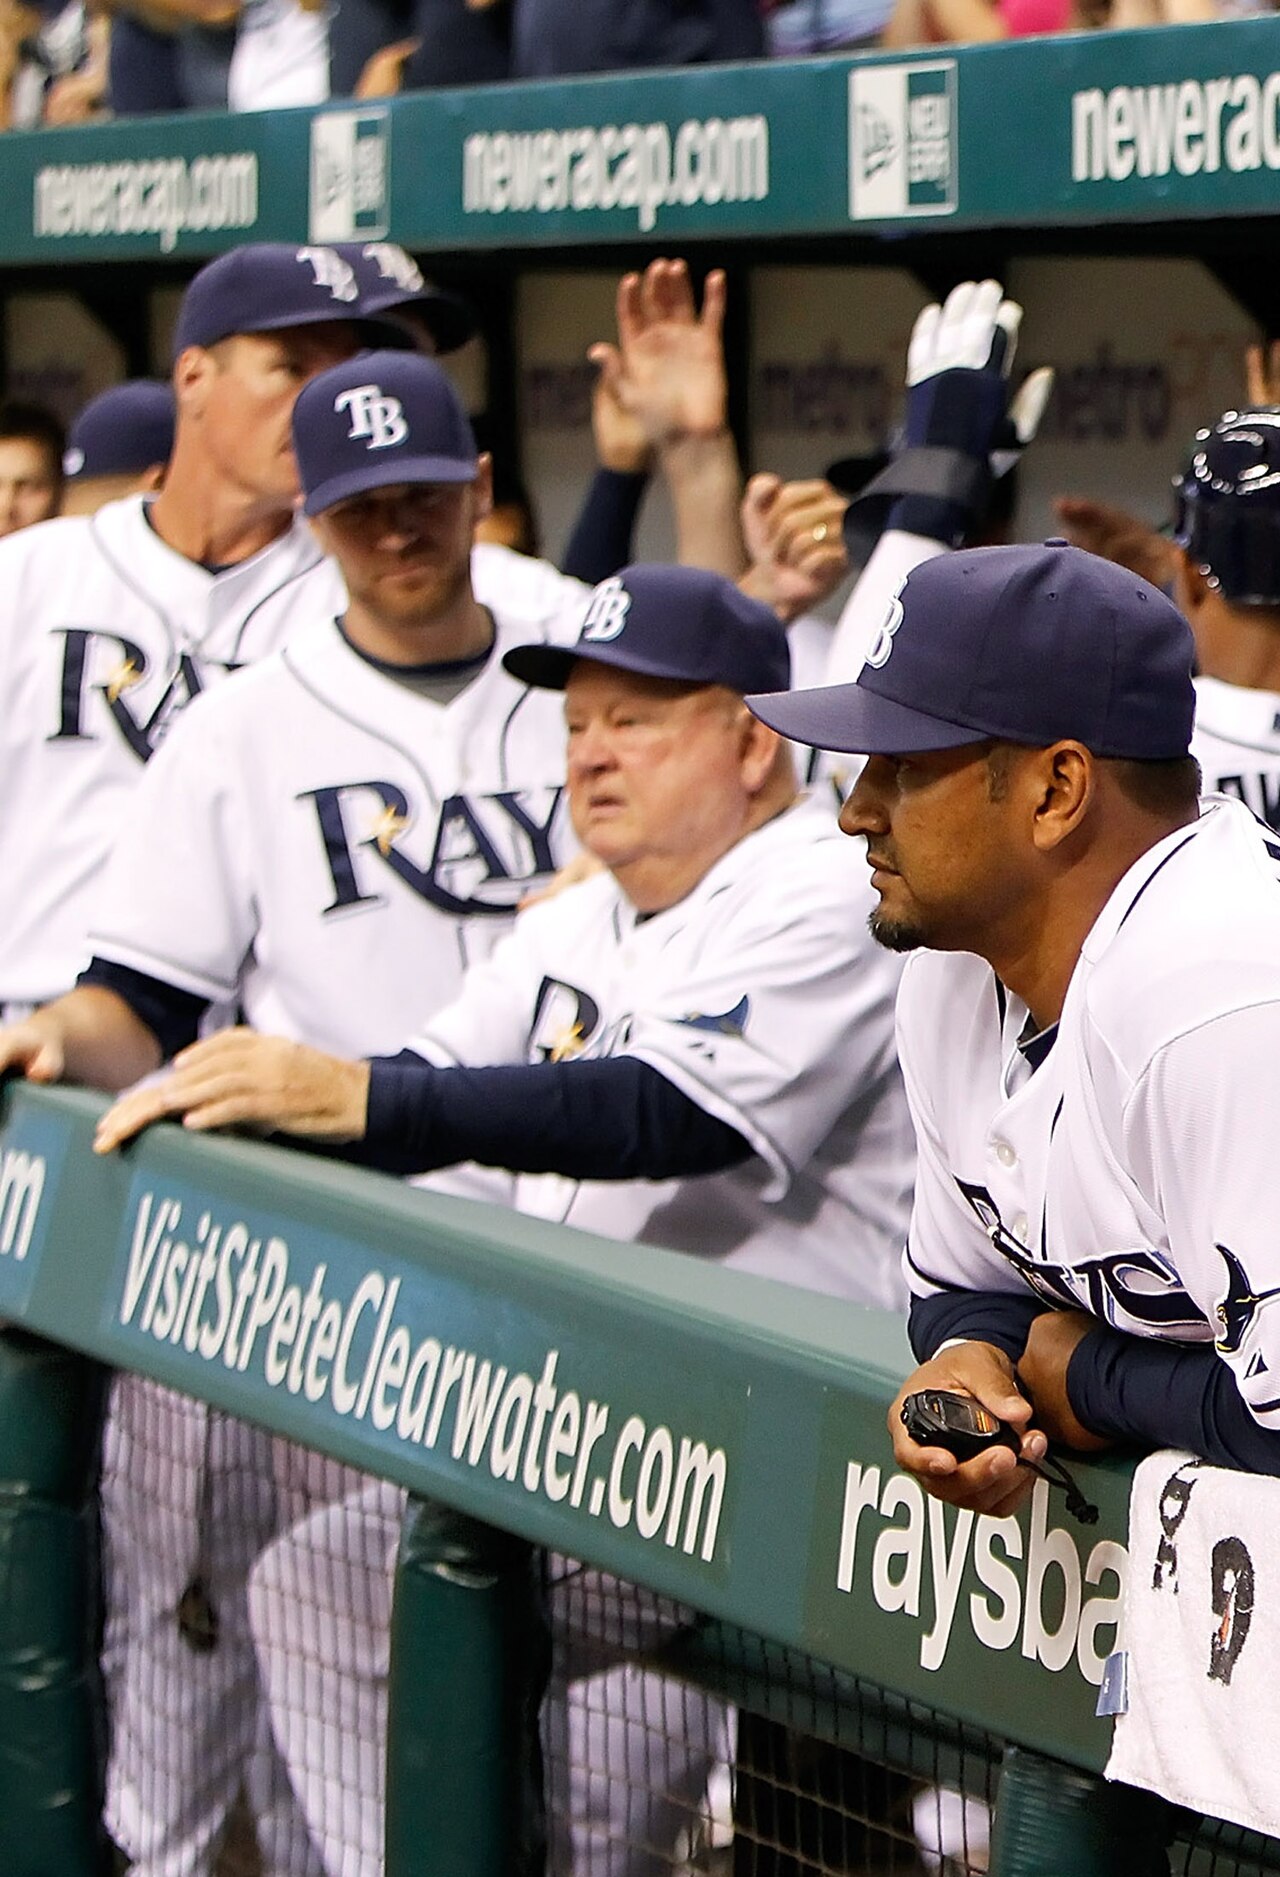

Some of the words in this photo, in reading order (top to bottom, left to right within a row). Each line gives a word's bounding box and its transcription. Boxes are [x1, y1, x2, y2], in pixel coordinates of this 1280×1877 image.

[33, 152, 258, 254] neweracap.com
[463, 114, 768, 232] neweracap.com
[333, 384, 410, 451] TB
[296, 781, 565, 915] RAY
[119, 1190, 728, 1563] VisitStPeteClearwater.com
[837, 1461, 1131, 1687] raysba
